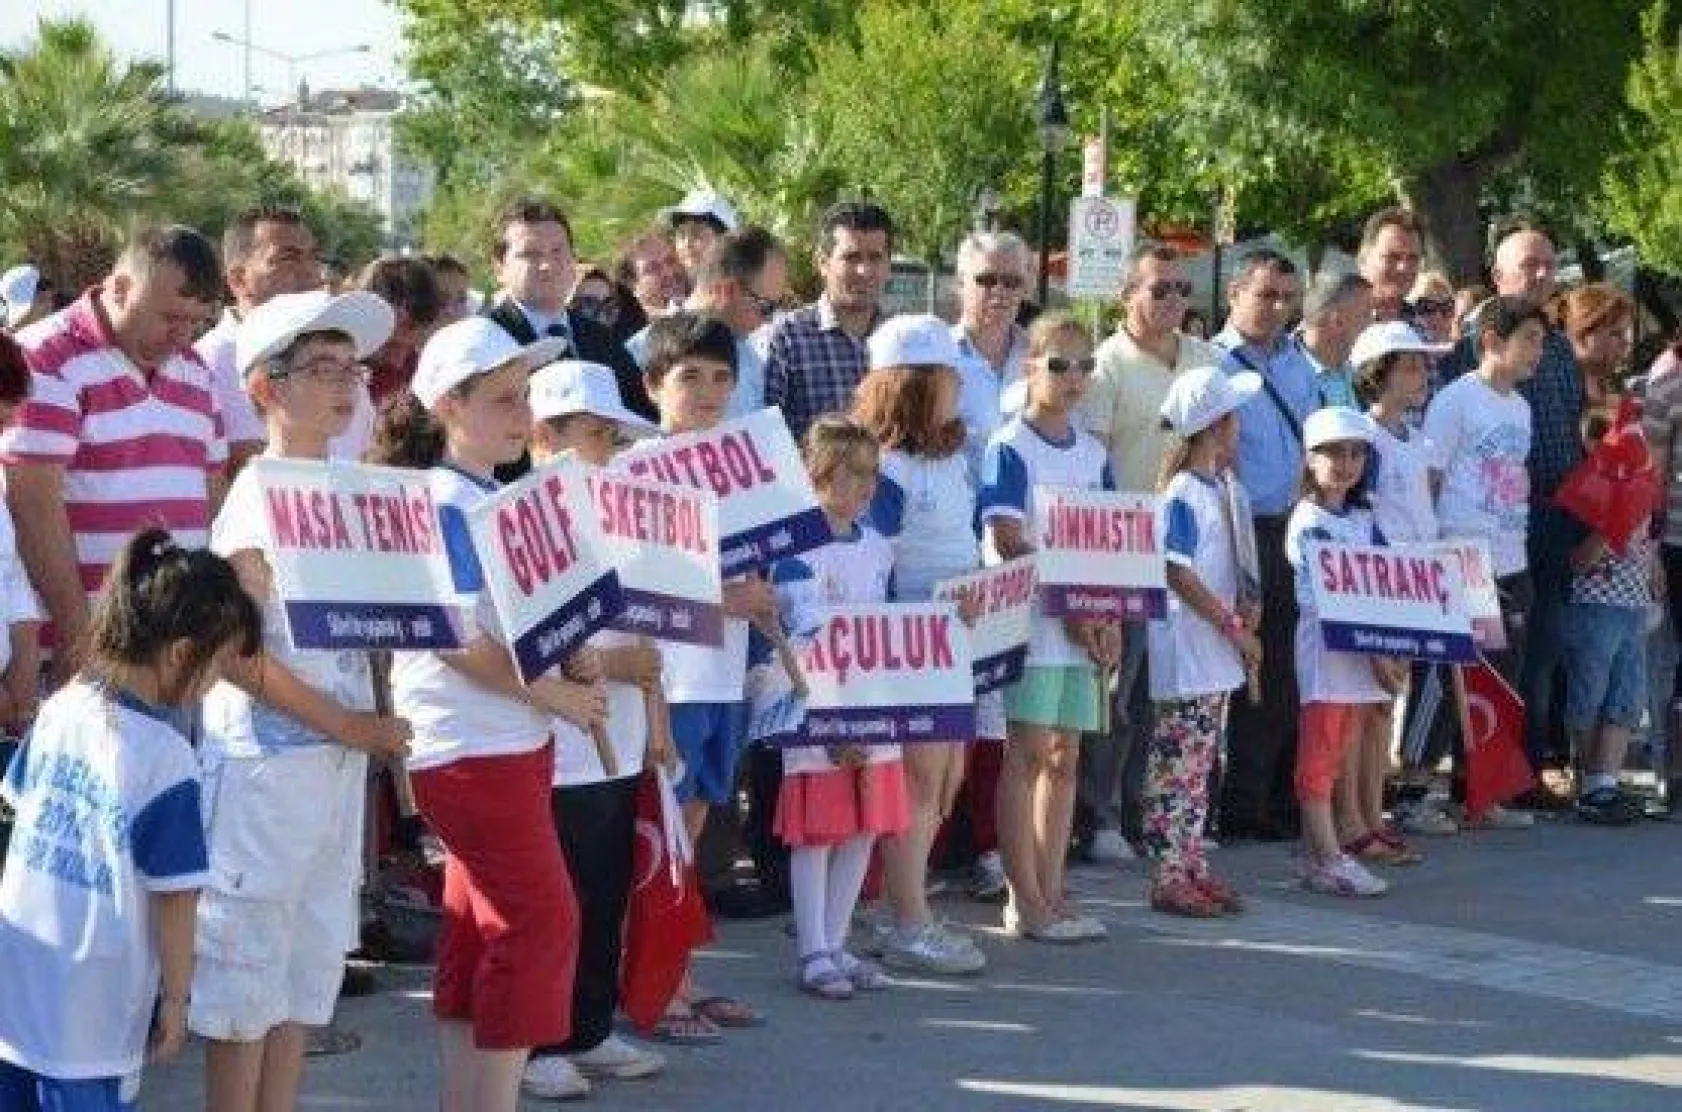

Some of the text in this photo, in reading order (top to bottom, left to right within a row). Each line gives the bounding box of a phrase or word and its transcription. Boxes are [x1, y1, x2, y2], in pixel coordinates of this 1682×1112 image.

[497, 475, 578, 598] GOLF
[587, 476, 708, 555] SKETBOL
[1319, 548, 1449, 616] SATRANÇ
